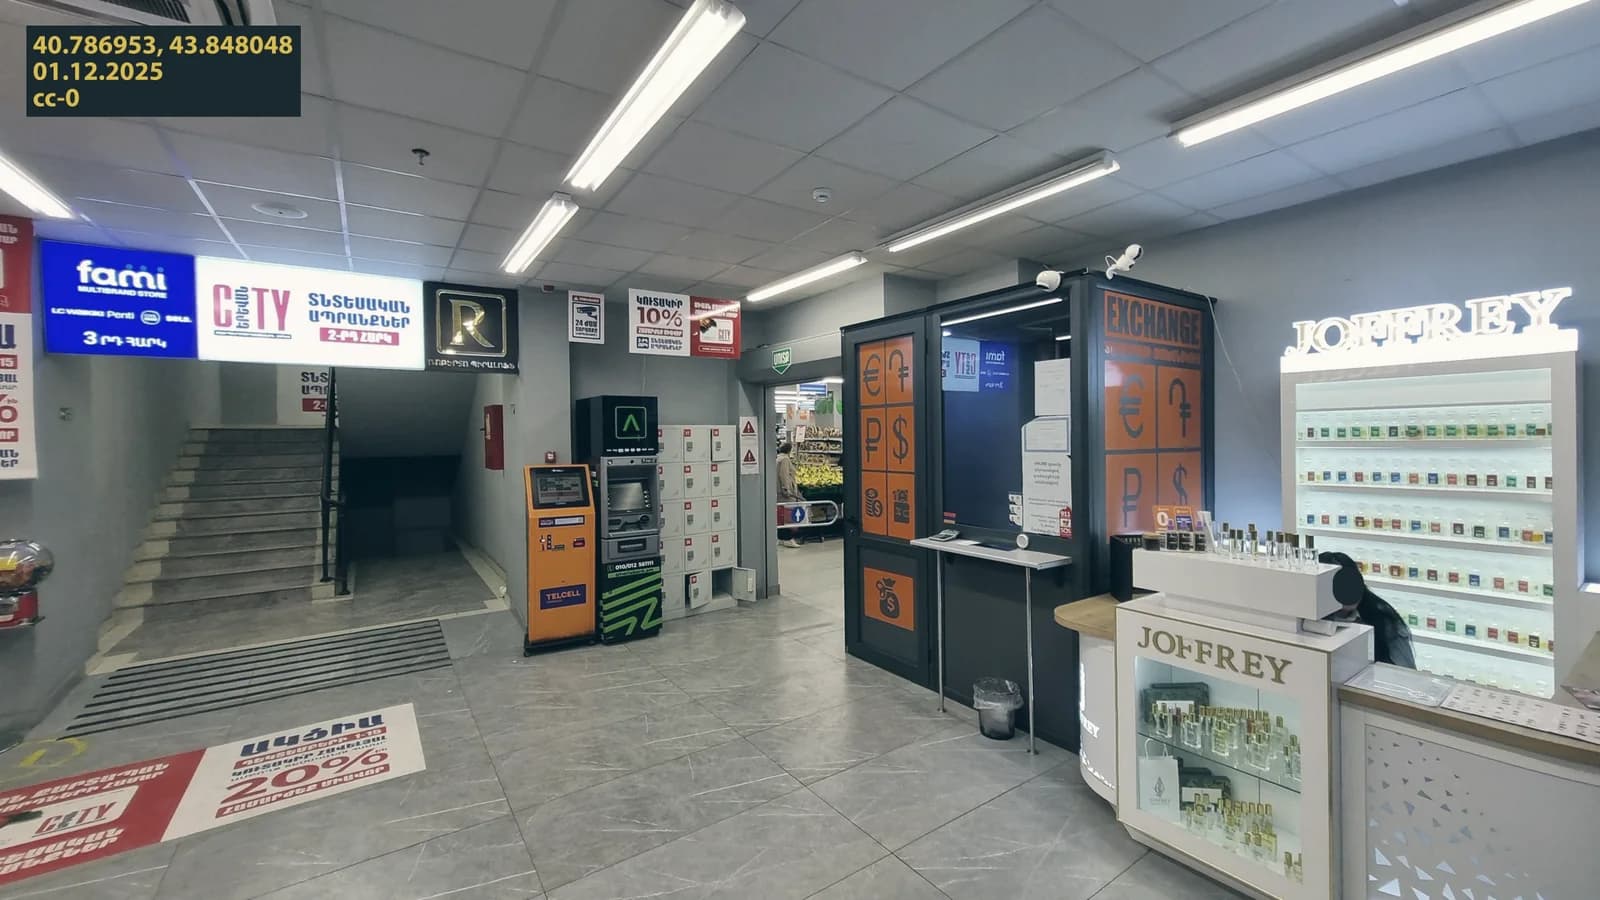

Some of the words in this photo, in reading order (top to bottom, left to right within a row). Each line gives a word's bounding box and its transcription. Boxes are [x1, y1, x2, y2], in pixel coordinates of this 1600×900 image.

[77, 260, 167, 291] fami
[137, 290, 167, 299] STORE
[308, 292, 411, 314] ՏՆՏԵՍԱԿԱՆ
[308, 310, 411, 328] ԱՊՐԱՆՔՆԵՐ
[449, 299, 496, 348] R
[637, 306, 683, 328] 10%
[1107, 296, 1200, 345] EXCHANGE
[1284, 286, 1574, 356] JOFFREY
[84, 331, 98, 346] 3
[546, 590, 582, 601] TELCELL
[1137, 626, 1293, 686] JOFFREY
[355, 728, 383, 740] 1-15
[220, 748, 389, 804] 20%
